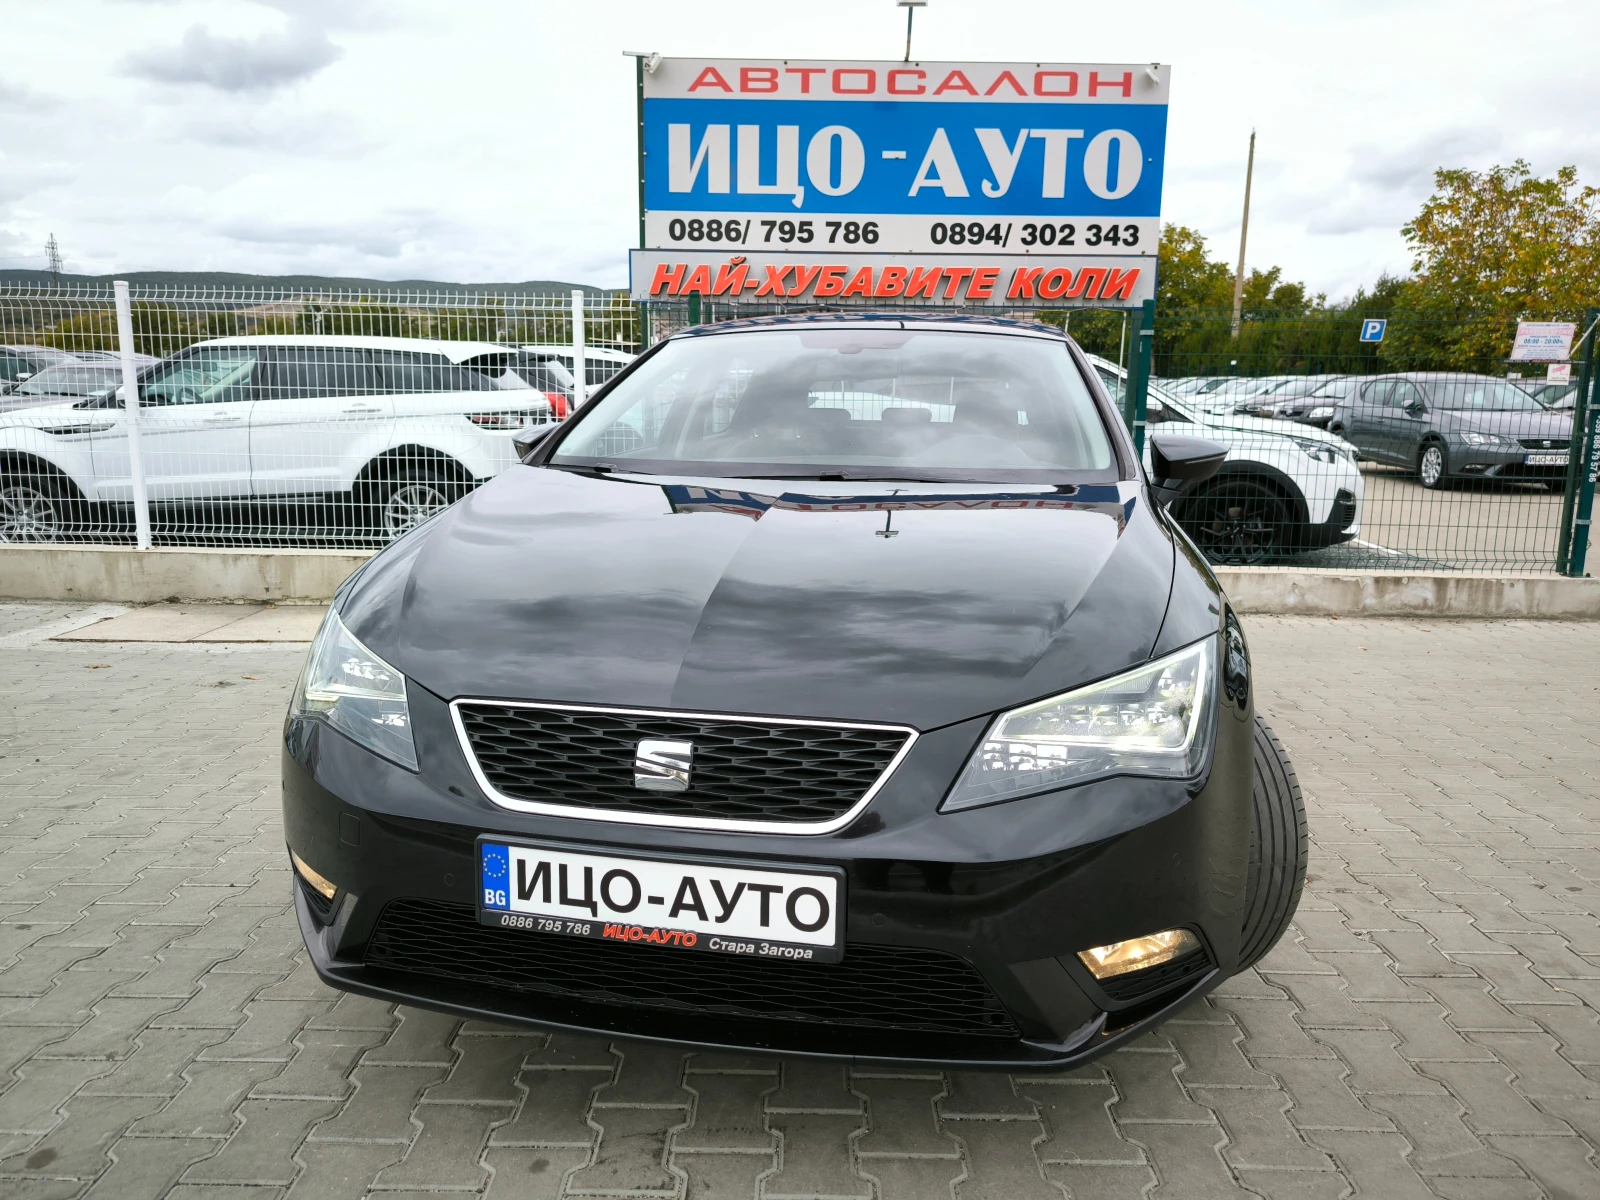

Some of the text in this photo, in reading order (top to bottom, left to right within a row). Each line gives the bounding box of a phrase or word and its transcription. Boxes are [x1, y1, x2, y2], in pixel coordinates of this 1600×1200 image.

[687, 66, 1133, 98] АВТОСАЛОН
[669, 218, 1140, 248] 0886/ 795 786 0894/ 302 343
[649, 255, 1141, 300] НАЙ-ХУБАВИТЕ КОЛИ
[1365, 322, 1381, 339] P
[1590, 462, 1598, 471] 57
[1591, 451, 1600, 460] 79
[1588, 473, 1597, 483] 86
[484, 889, 506, 906] BG
[516, 858, 830, 932] ИЦО-АУТО
[501, 914, 813, 960] 0886 795 786 ИЦО-АУТО Стара Загора
